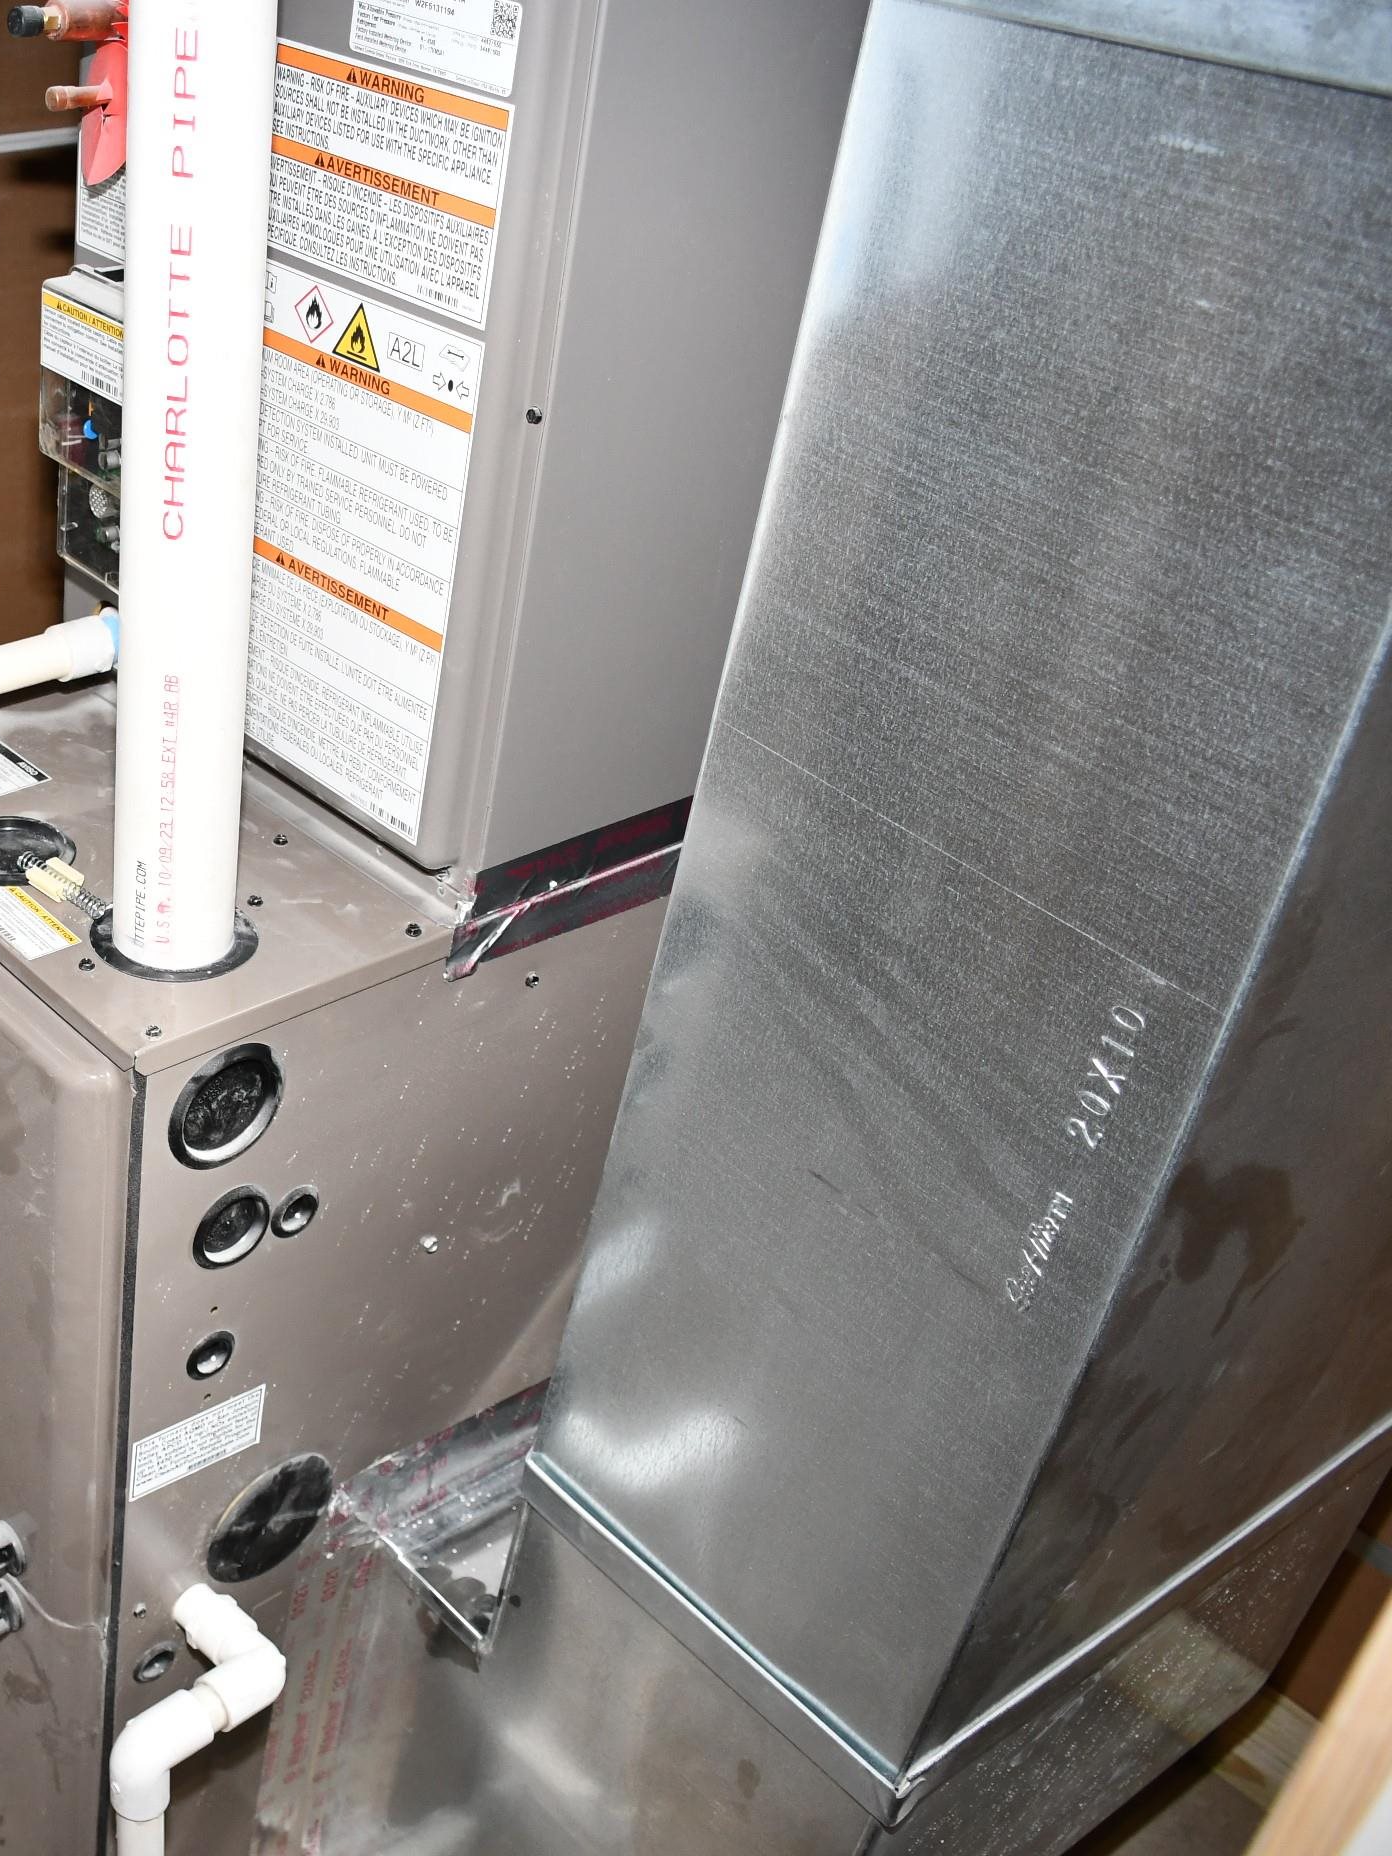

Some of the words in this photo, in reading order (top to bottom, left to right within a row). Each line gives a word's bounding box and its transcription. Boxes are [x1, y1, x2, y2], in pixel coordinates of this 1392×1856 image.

[171, 27, 198, 178] PIPE
[276, 65, 304, 87] WARNING
[310, 75, 324, 93] RISK
[325, 80, 334, 97] OF
[335, 83, 349, 101] FIRE
[355, 89, 388, 113] AUXILIARY
[390, 100, 419, 123] DEVICES
[419, 109, 442, 130] WHICH
[443, 116, 458, 135] MAY
[459, 121, 470, 139] BE
[470, 125, 503, 149] IGNITION
[359, 70, 424, 103] WARNING
[272, 118, 283, 135] SEE
[284, 122, 330, 150] INSTRUCTIONS.
[274, 101, 304, 124] AUXILIARY
[305, 111, 331, 133] DEVICES
[332, 119, 355, 140] LISTED
[355, 127, 370, 145] FOR
[370, 132, 384, 150] USE
[385, 136, 402, 156] WITH
[402, 142, 416, 160] THE
[417, 147, 449, 171] SPECIFIC
[450, 158, 493, 185] APPLIANCE.
[275, 83, 303, 105] SOURCES
[304, 92, 325, 112] SHALL
[326, 99, 339, 117] NOT
[340, 103, 349, 120] BE
[349, 106, 385, 131] INSTALLED
[386, 118, 393, 134] IN
[394, 120, 408, 138] THE
[451, 139, 477, 160] OTHER
[477, 147, 498, 167] THAN
[322, 173, 345, 195] RISQUE
[388, 196, 402, 215] LES
[403, 201, 444, 230] DISPOSITIFS
[445, 216, 489, 245] AUXILIAIRES
[326, 156, 439, 206] AVERTISSEMENT
[278, 176, 305, 199] PEUVENT
[324, 192, 336, 210] DES
[337, 197, 368, 221] SOURCES
[426, 228, 436, 245] NE
[437, 232, 468, 257] DOIVENT
[469, 243, 484, 262] PAS
[314, 206, 331, 226] DANS
[332, 213, 344, 231] LES
[423, 246, 437, 265] DES
[438, 252, 481, 281] DISPOSITIFS
[298, 235, 334, 262] CONSULTEZ
[335, 249, 348, 267] LES
[345, 235, 363, 255] POUR
[364, 243, 378, 261] UNE
[420, 264, 439, 284] AVEC
[62, 304, 87, 321] CAUTION
[162, 224, 193, 540] CHARLOTTE
[329, 358, 390, 396] WARNING
[390, 337, 420, 369] A2L
[288, 558, 390, 621] AVERTISSEMENT
